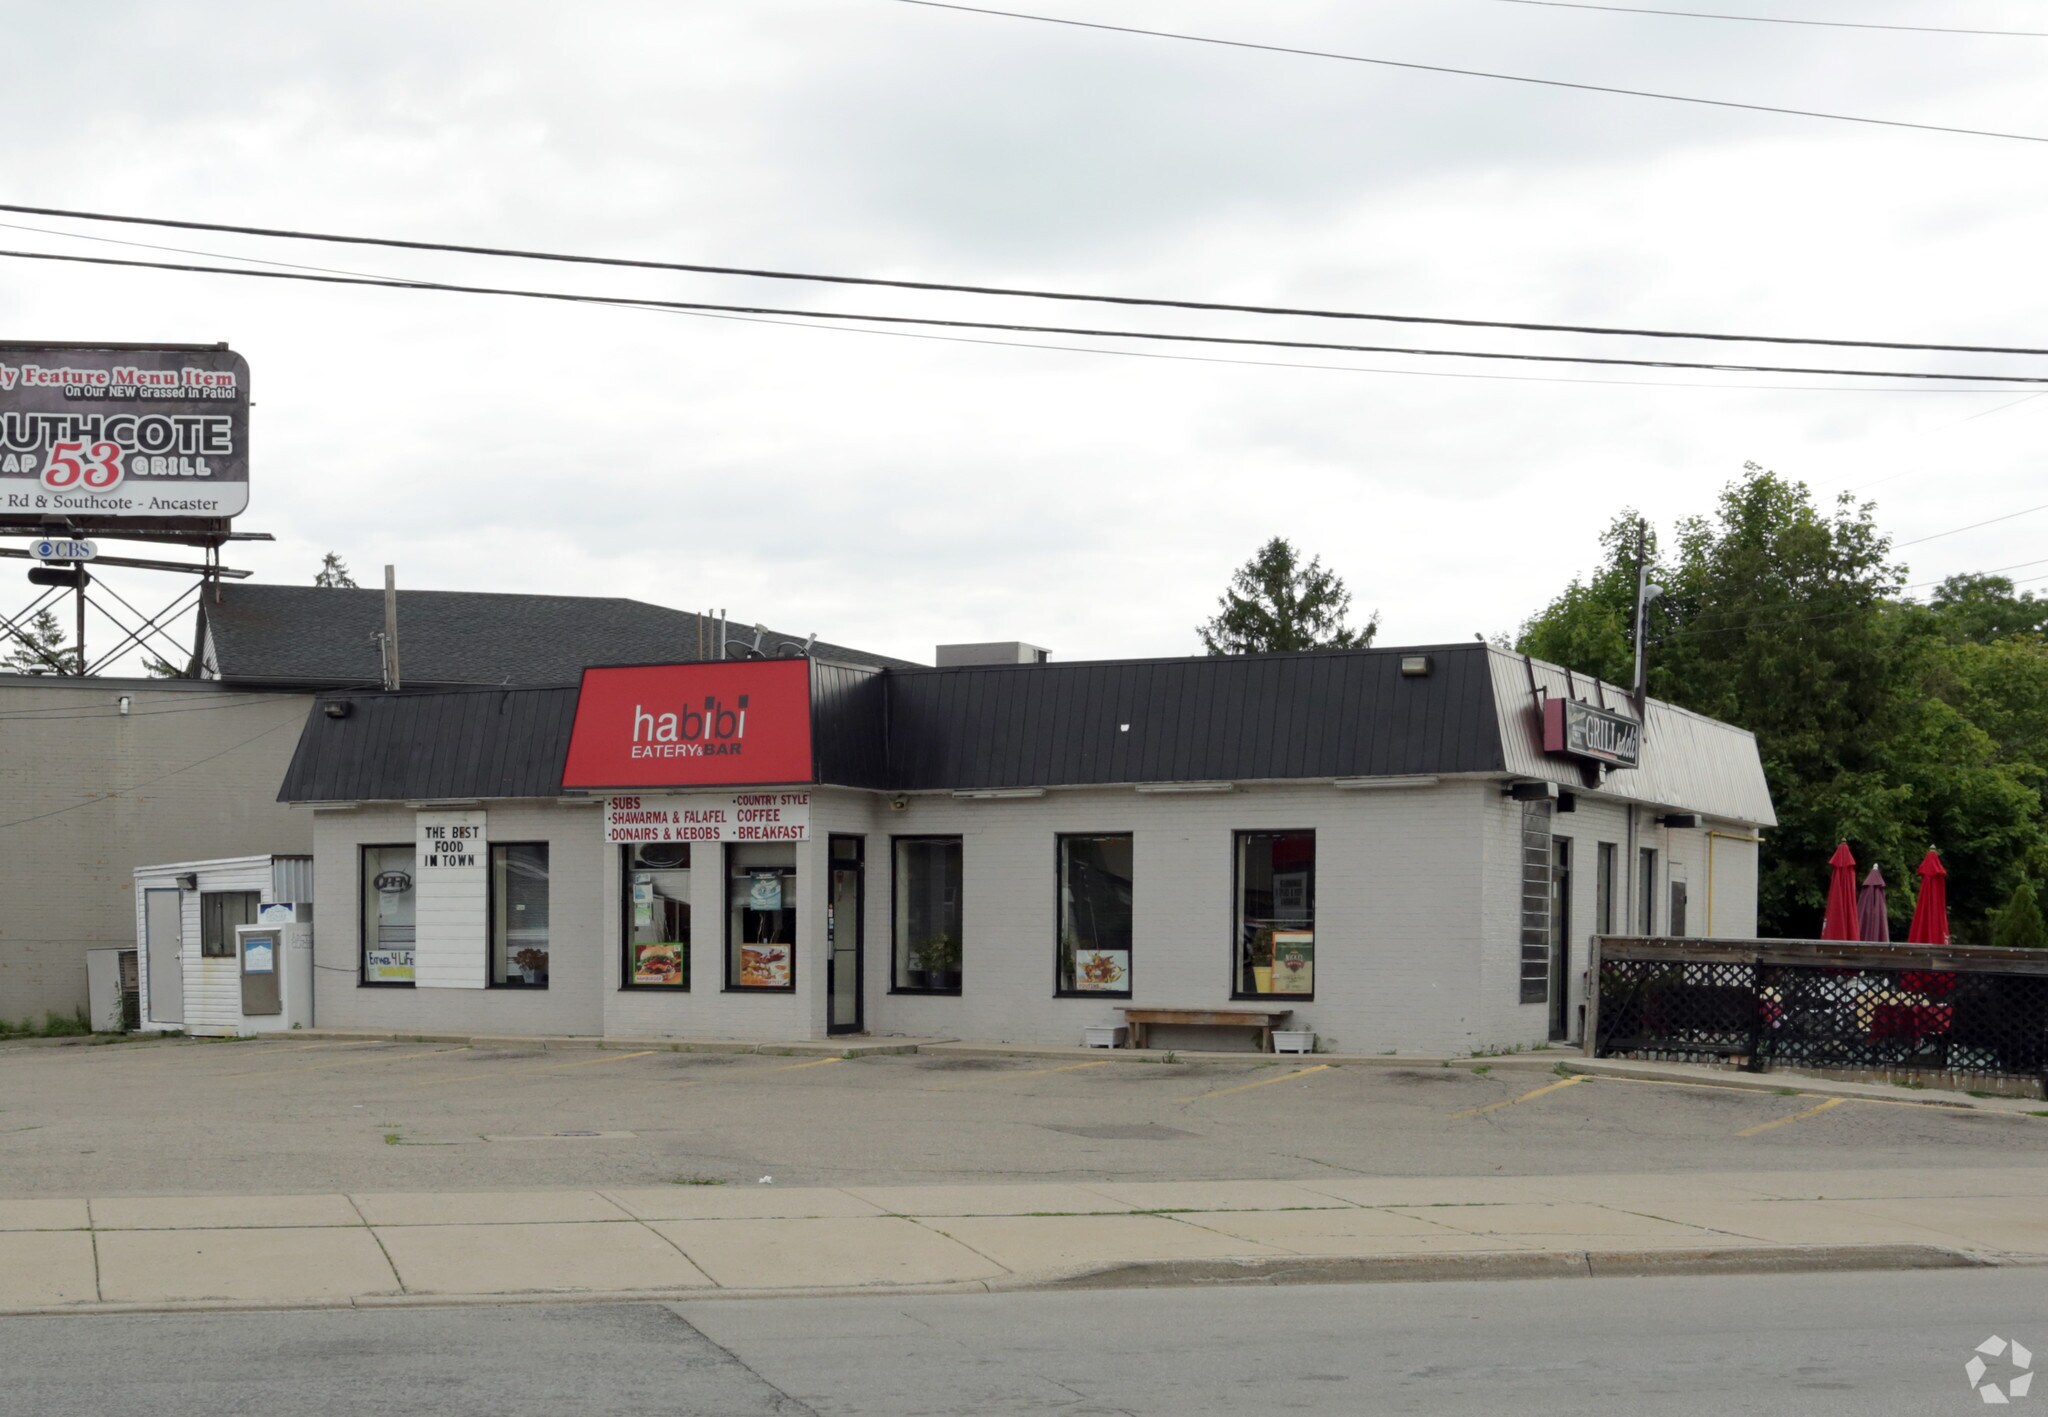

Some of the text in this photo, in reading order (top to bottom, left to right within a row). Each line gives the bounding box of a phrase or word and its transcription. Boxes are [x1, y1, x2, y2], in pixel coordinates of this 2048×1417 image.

[25, 367, 107, 384] Feature
[116, 370, 176, 385] Menu
[185, 371, 233, 386] Item
[65, 385, 236, 399] On Our NEW Grassed in Patio!
[0, 442, 211, 487] AP 53 GRILL
[8, 494, 29, 508] Rd
[35, 495, 48, 508] &
[53, 495, 132, 509] Southcote
[149, 497, 218, 511] Ancaster
[56, 542, 90, 558] CBS
[632, 694, 749, 742] habibi
[612, 797, 640, 810] SUBS
[737, 794, 808, 806] COUNTRY STYLE
[612, 810, 727, 824] SHAWARMA & FALAFEL
[737, 809, 780, 822] COFFEE
[425, 826, 479, 839] THE BEST
[612, 826, 720, 840] DONAIRS & KEBOBS
[738, 826, 804, 839] BREAKFAST
[435, 841, 463, 853] FOOD
[425, 855, 475, 866] IN TOWN
